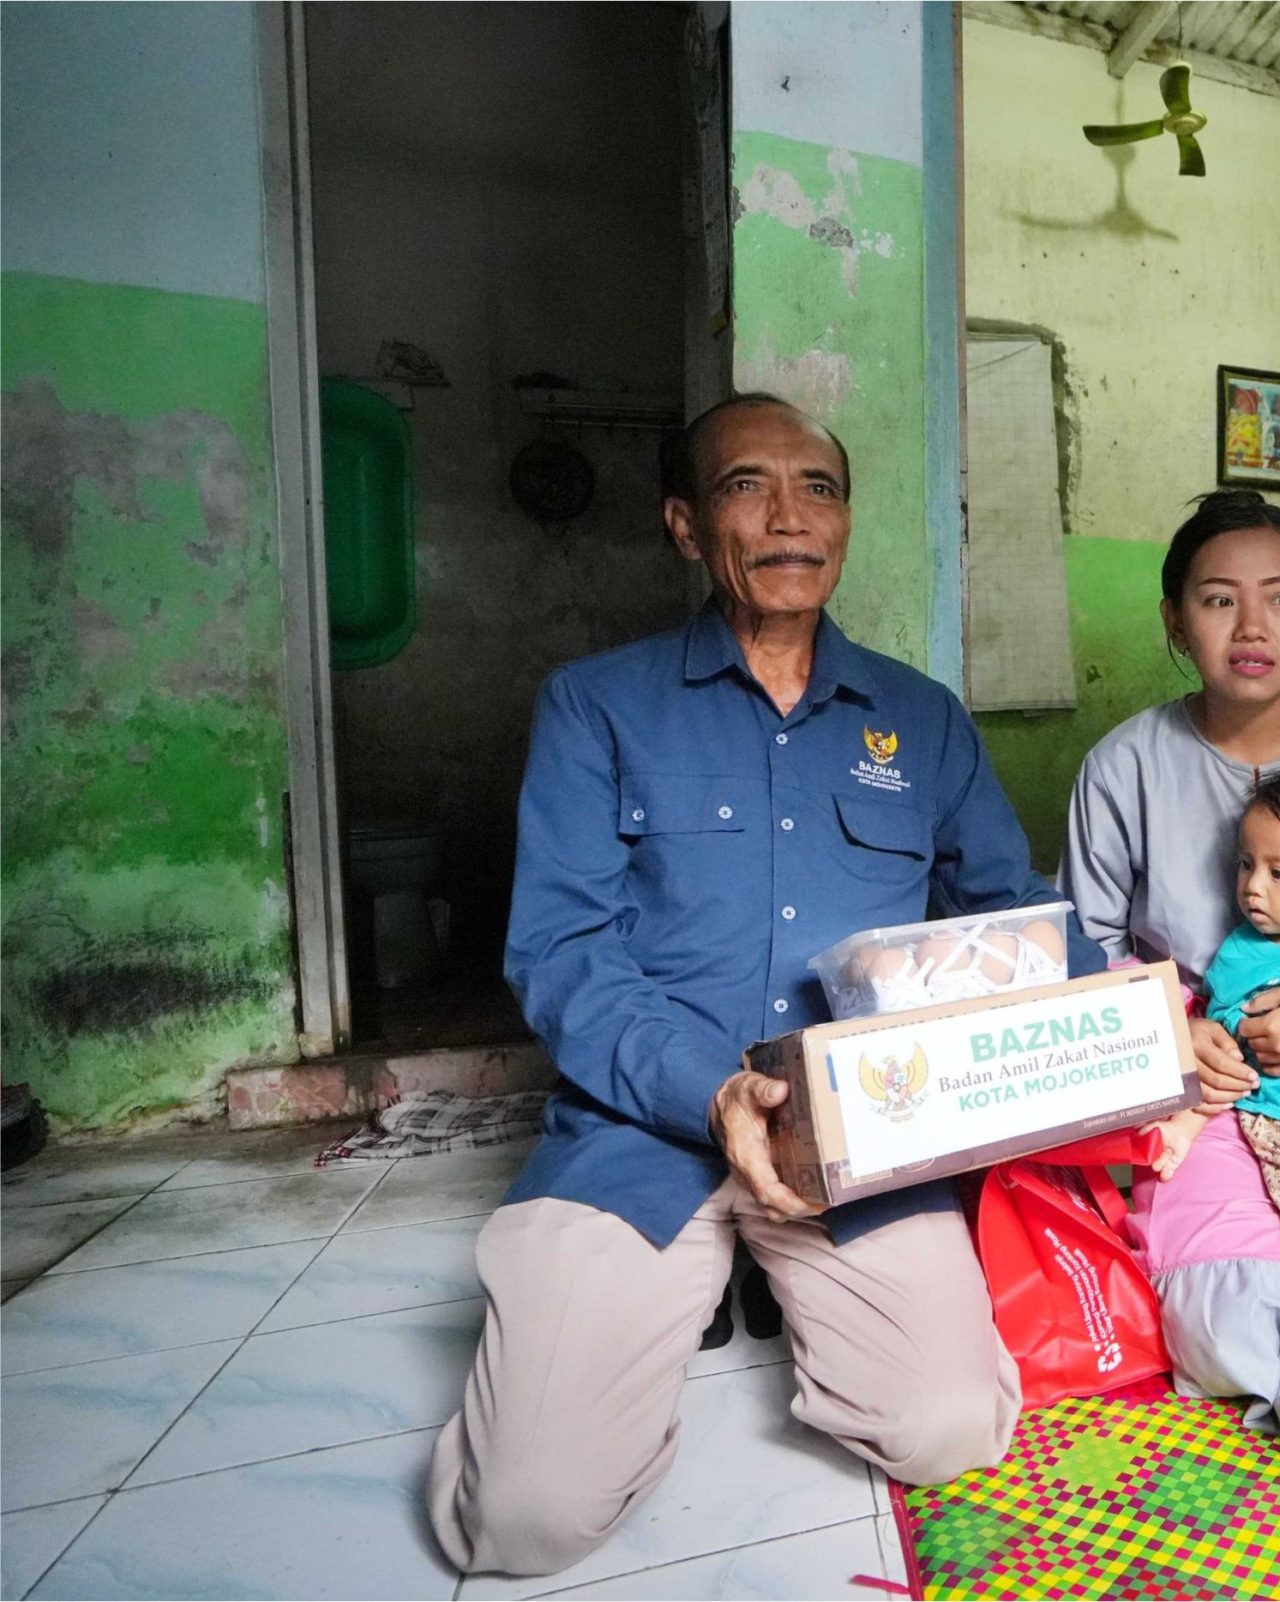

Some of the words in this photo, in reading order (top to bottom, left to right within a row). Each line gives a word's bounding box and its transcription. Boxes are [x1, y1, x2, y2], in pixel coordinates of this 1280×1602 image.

[859, 760, 901, 779] BAZNAS
[938, 1070, 993, 1092] Badan
[999, 1056, 1039, 1079] Amil
[1044, 1046, 1089, 1069] Zakat
[1093, 1030, 1159, 1057] Nasional
[970, 1007, 1122, 1063] BAZNAS
[958, 1084, 1019, 1112] KOTA
[1024, 1053, 1149, 1097] MOJOKERTO
